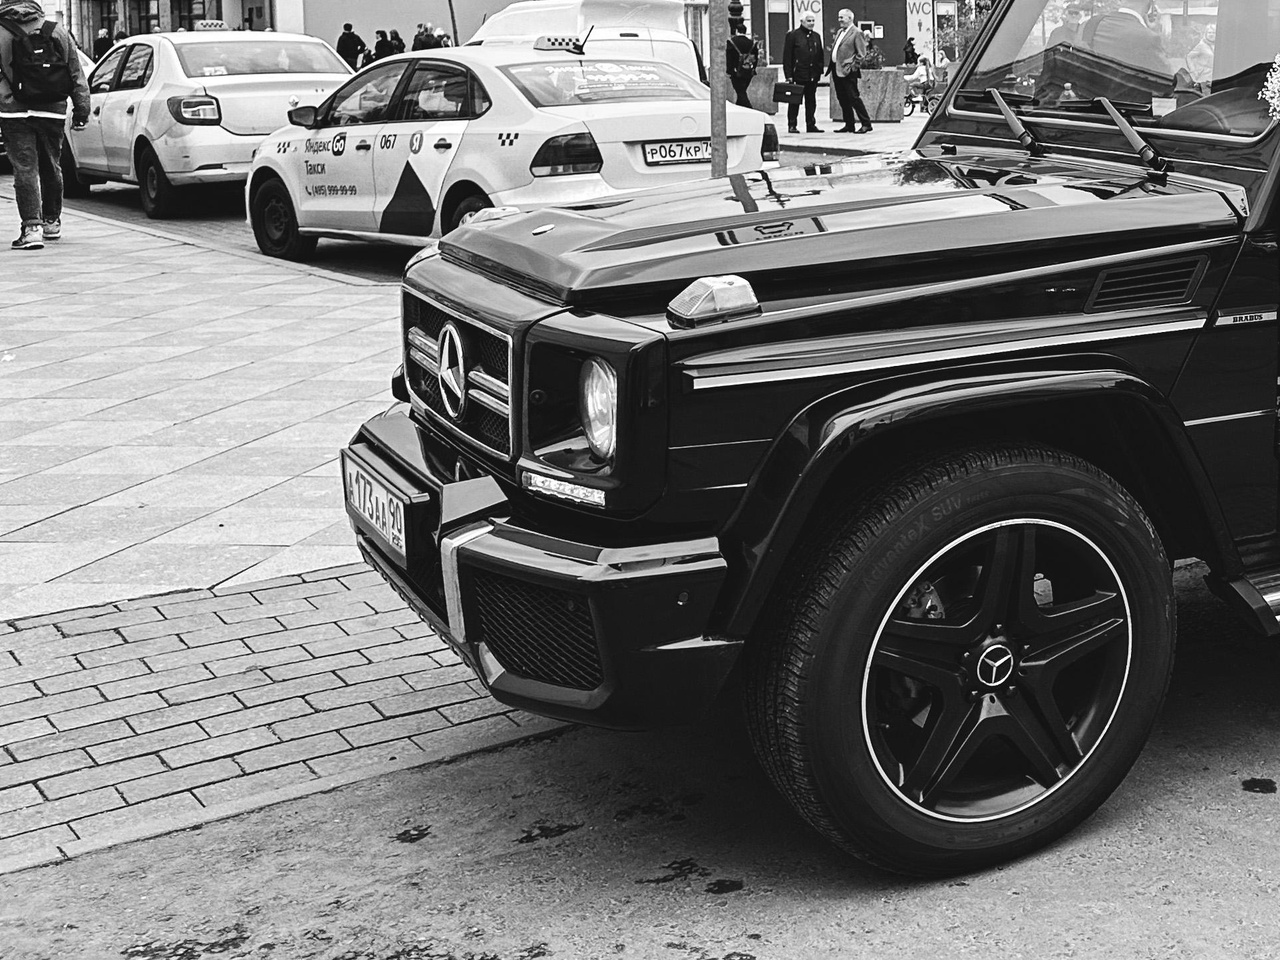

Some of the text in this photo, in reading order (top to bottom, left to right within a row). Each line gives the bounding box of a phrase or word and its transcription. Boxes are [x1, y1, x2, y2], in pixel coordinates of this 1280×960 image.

[795, 0, 822, 14] WC
[907, 1, 932, 15] WC
[304, 138, 332, 155] Яндекс
[379, 133, 398, 150] 067
[649, 143, 702, 160] Р067КР
[304, 160, 326, 175] Такси
[312, 184, 358, 197] (495) 999-99-99
[1232, 314, 1264, 323] BRABUS
[348, 469, 403, 536] А173АА 90
[931, 492, 962, 521] SUV
